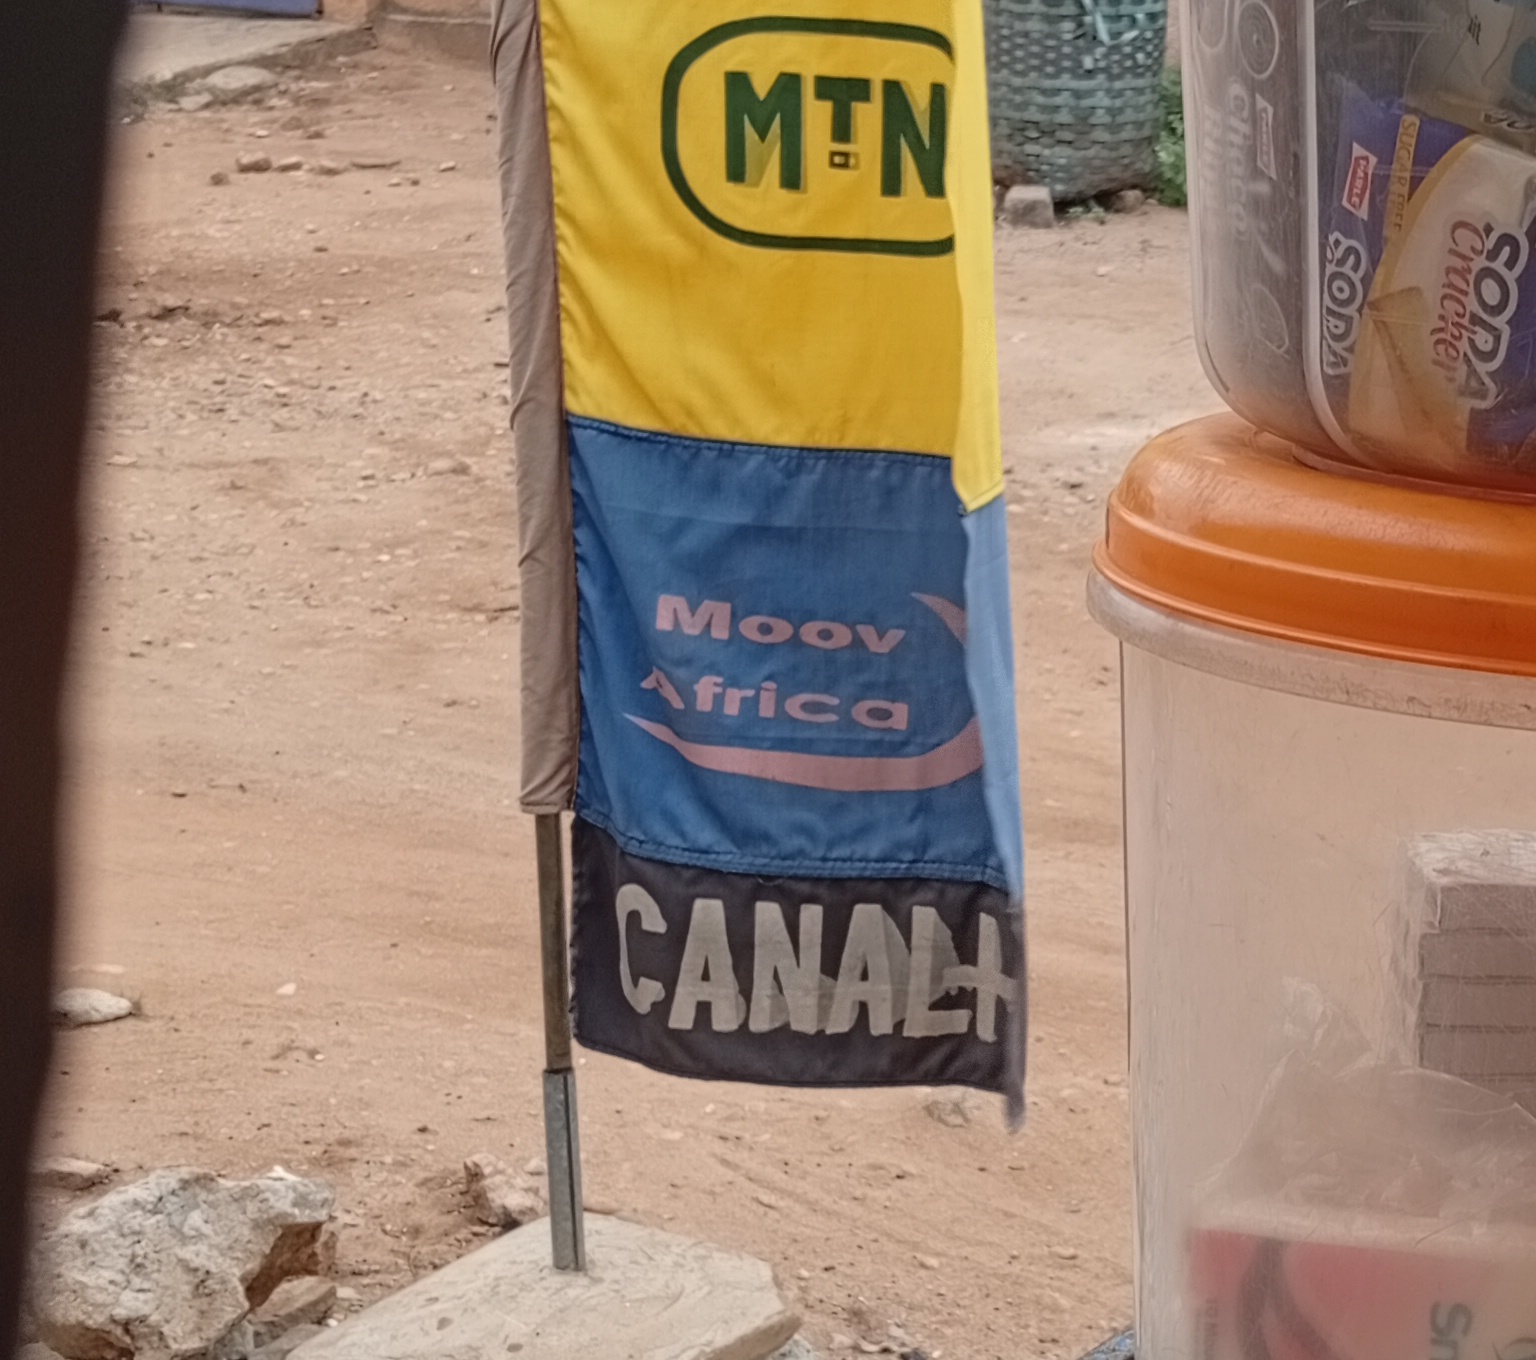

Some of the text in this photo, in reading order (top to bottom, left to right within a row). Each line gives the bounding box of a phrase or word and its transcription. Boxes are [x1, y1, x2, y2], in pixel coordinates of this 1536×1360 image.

[723, 68, 946, 199] MTN
[1349, 157, 1368, 209] PARLE
[1393, 118, 1415, 185] SUGAR
[1324, 238, 1365, 372] SODA
[1432, 220, 1487, 380] Cracker
[1461, 224, 1523, 403] SODA
[652, 591, 907, 656] Moov
[638, 666, 910, 732] Africa
[614, 881, 1016, 1043] CANAL+
